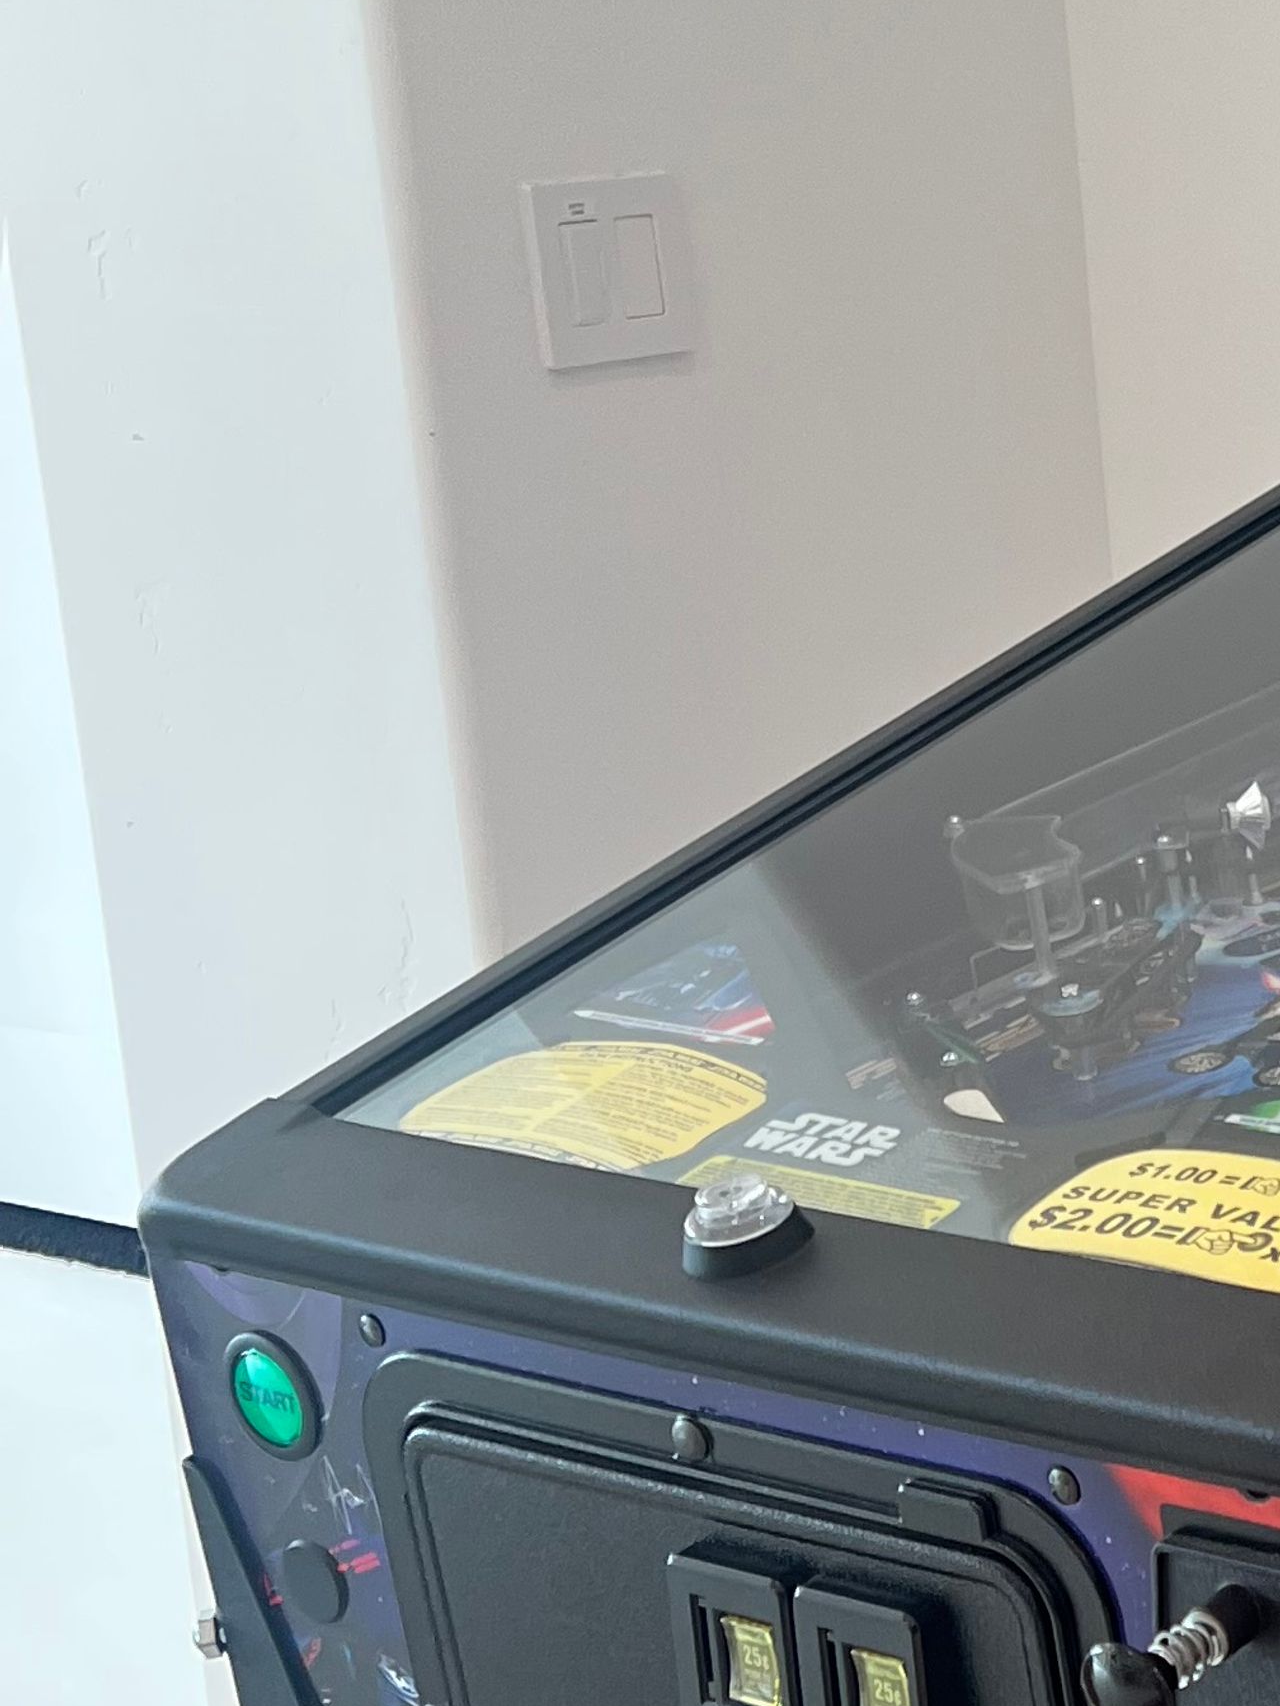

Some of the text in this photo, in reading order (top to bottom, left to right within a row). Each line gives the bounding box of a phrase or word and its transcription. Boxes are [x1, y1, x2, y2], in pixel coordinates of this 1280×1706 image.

[744, 1127, 890, 1166] WARS
[763, 1113, 900, 1150] STAR
[1062, 1185, 1197, 1214] SUPER
[240, 1381, 295, 1414] START
